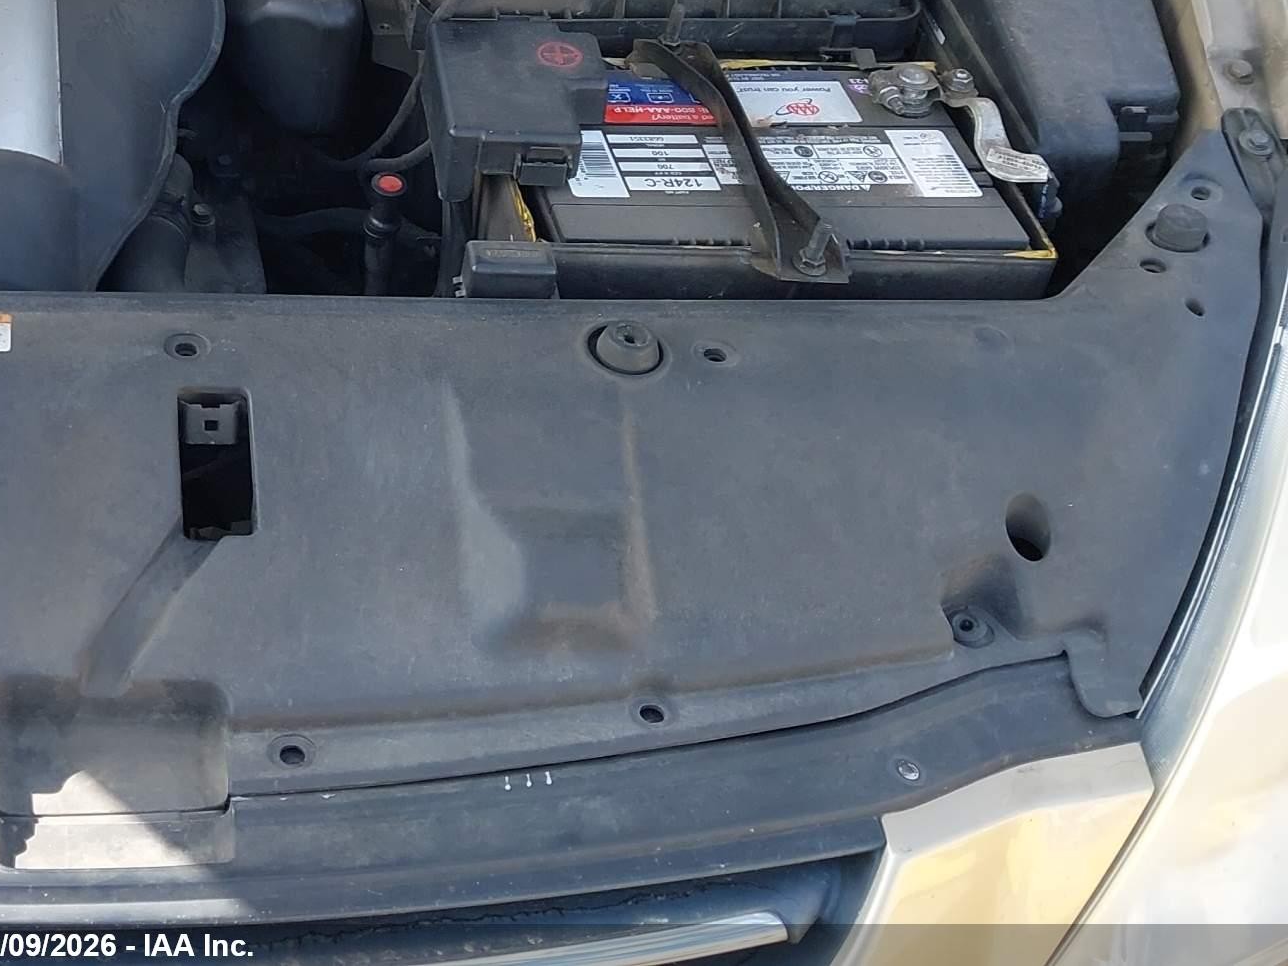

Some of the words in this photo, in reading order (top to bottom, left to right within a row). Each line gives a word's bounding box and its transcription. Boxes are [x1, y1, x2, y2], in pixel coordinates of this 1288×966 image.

[781, 85, 799, 93] you
[790, 104, 815, 115] AAA
[644, 178, 702, 188] 124R-C
